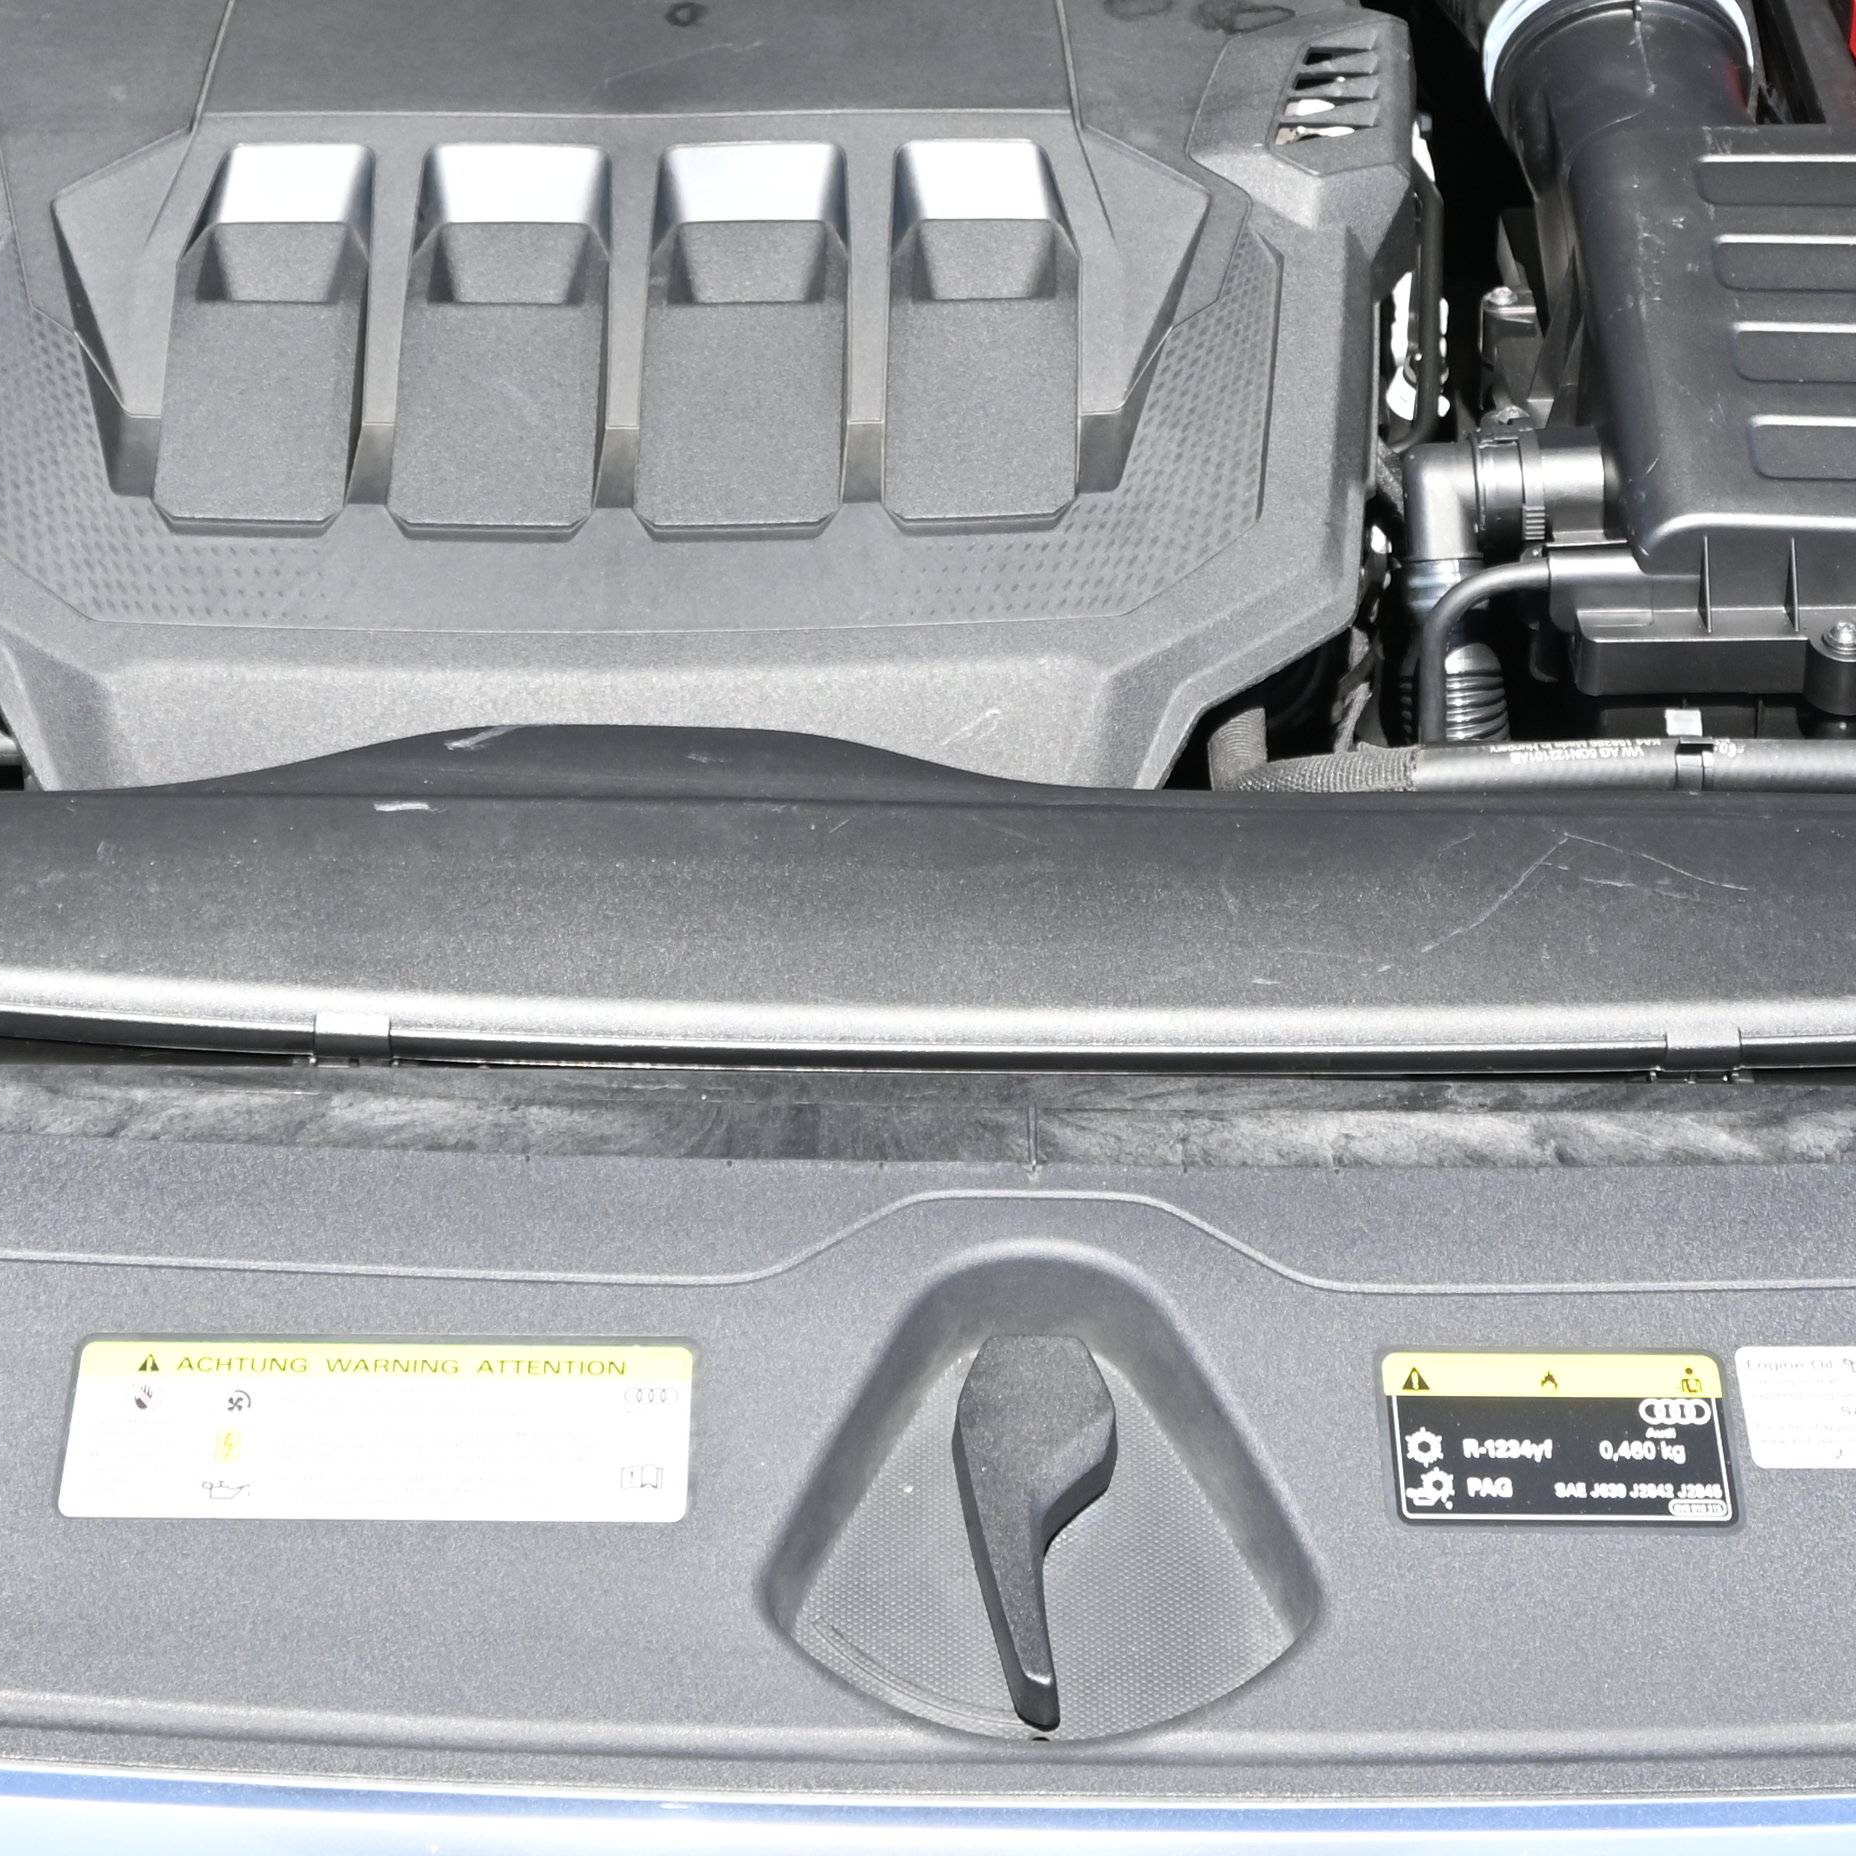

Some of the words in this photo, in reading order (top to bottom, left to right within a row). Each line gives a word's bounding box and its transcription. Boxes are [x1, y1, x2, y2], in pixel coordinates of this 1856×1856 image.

[1599, 747, 1619, 759] AG
[1622, 746, 1645, 758] VW
[176, 1355, 308, 1374] ACHTUNG
[325, 1356, 459, 1375] WARNING
[476, 1357, 627, 1376] ATTENTION
[1746, 1359, 1805, 1372] Engine
[1810, 1358, 1834, 1370] Oil
[1462, 1438, 1553, 1463] R-1234yf
[1660, 1440, 1686, 1464] kg
[1467, 1477, 1514, 1498] PAG
[1554, 1481, 1587, 1498] SAE
